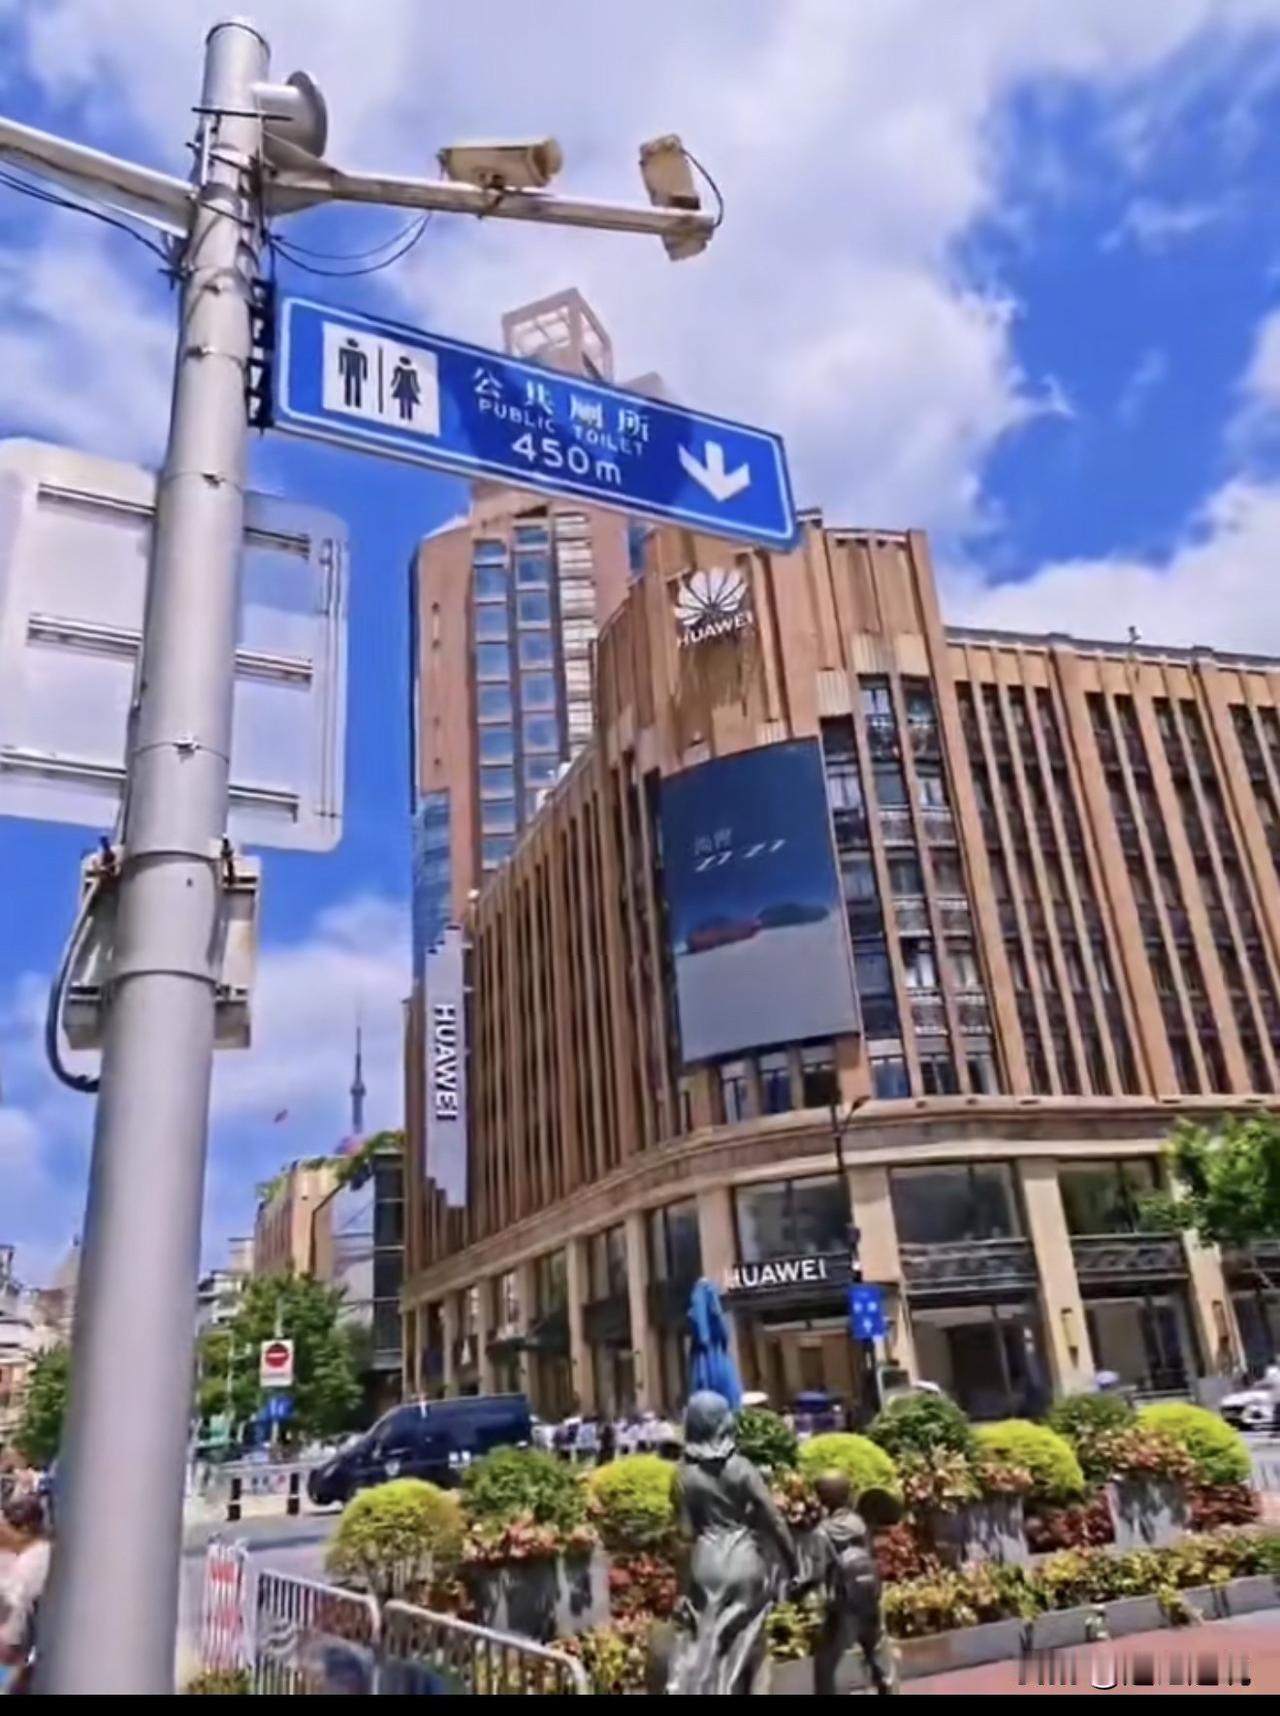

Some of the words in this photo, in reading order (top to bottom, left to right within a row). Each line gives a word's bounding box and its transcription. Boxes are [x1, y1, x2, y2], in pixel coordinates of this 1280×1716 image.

[479, 398, 556, 433] PUBLIC
[572, 424, 643, 456] TOILET
[511, 432, 622, 485] 450m
[676, 609, 753, 648] HUAWEI
[433, 1004, 459, 1121] HUAWEI
[725, 1258, 828, 1289] HUAWEI
